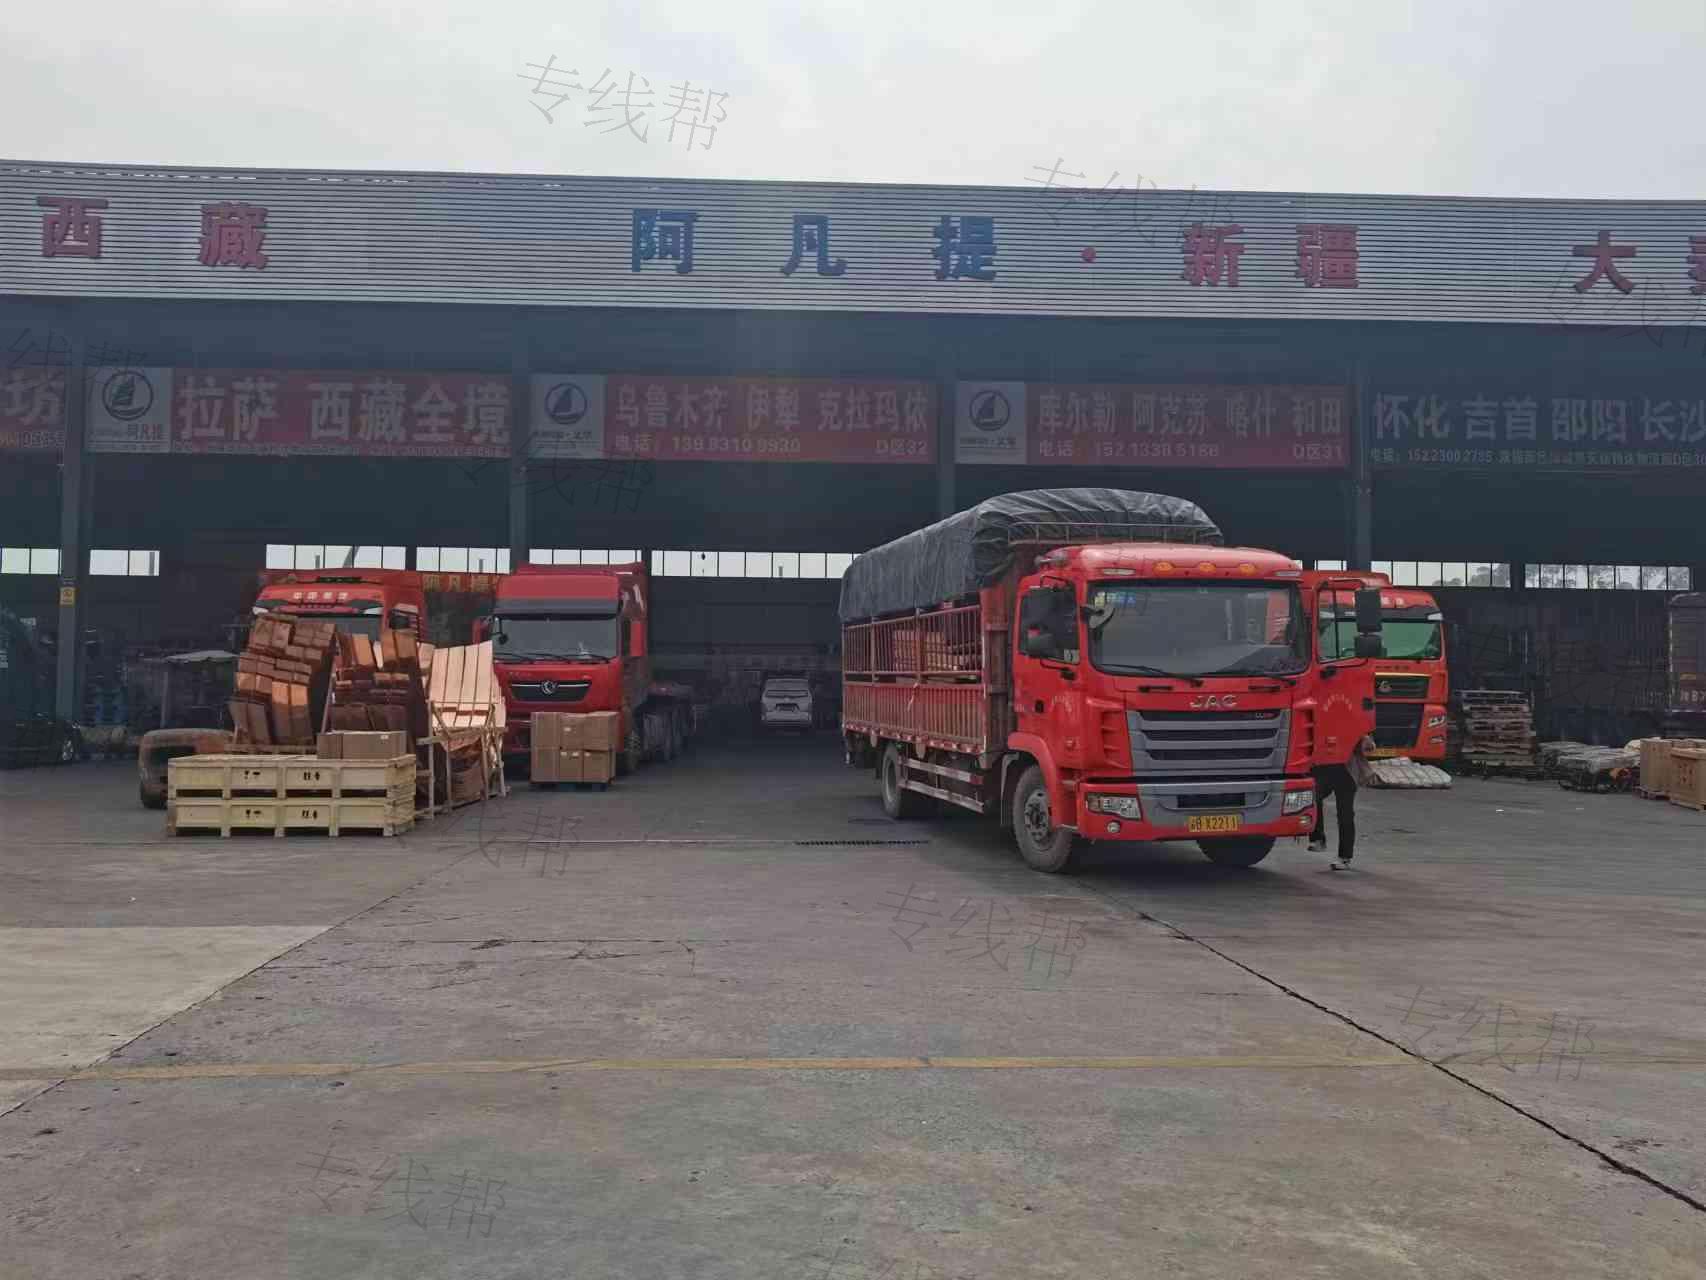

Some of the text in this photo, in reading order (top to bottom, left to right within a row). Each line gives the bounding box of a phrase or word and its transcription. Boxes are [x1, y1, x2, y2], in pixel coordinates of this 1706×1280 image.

[37, 196, 268, 270] 西藏
[178, 376, 510, 444] 拉萨 西藏全境
[615, 384, 728, 432] 乌鲁木齐
[817, 385, 929, 433] 克拉玛依
[1039, 389, 1117, 434] 库尔勒
[1291, 393, 1344, 437] 和田
[1371, 391, 1456, 441] 怀化
[1460, 391, 1538, 441] 吉首
[1551, 395, 1628, 445] 邵阳
[1189, 694, 1238, 709] JAC
